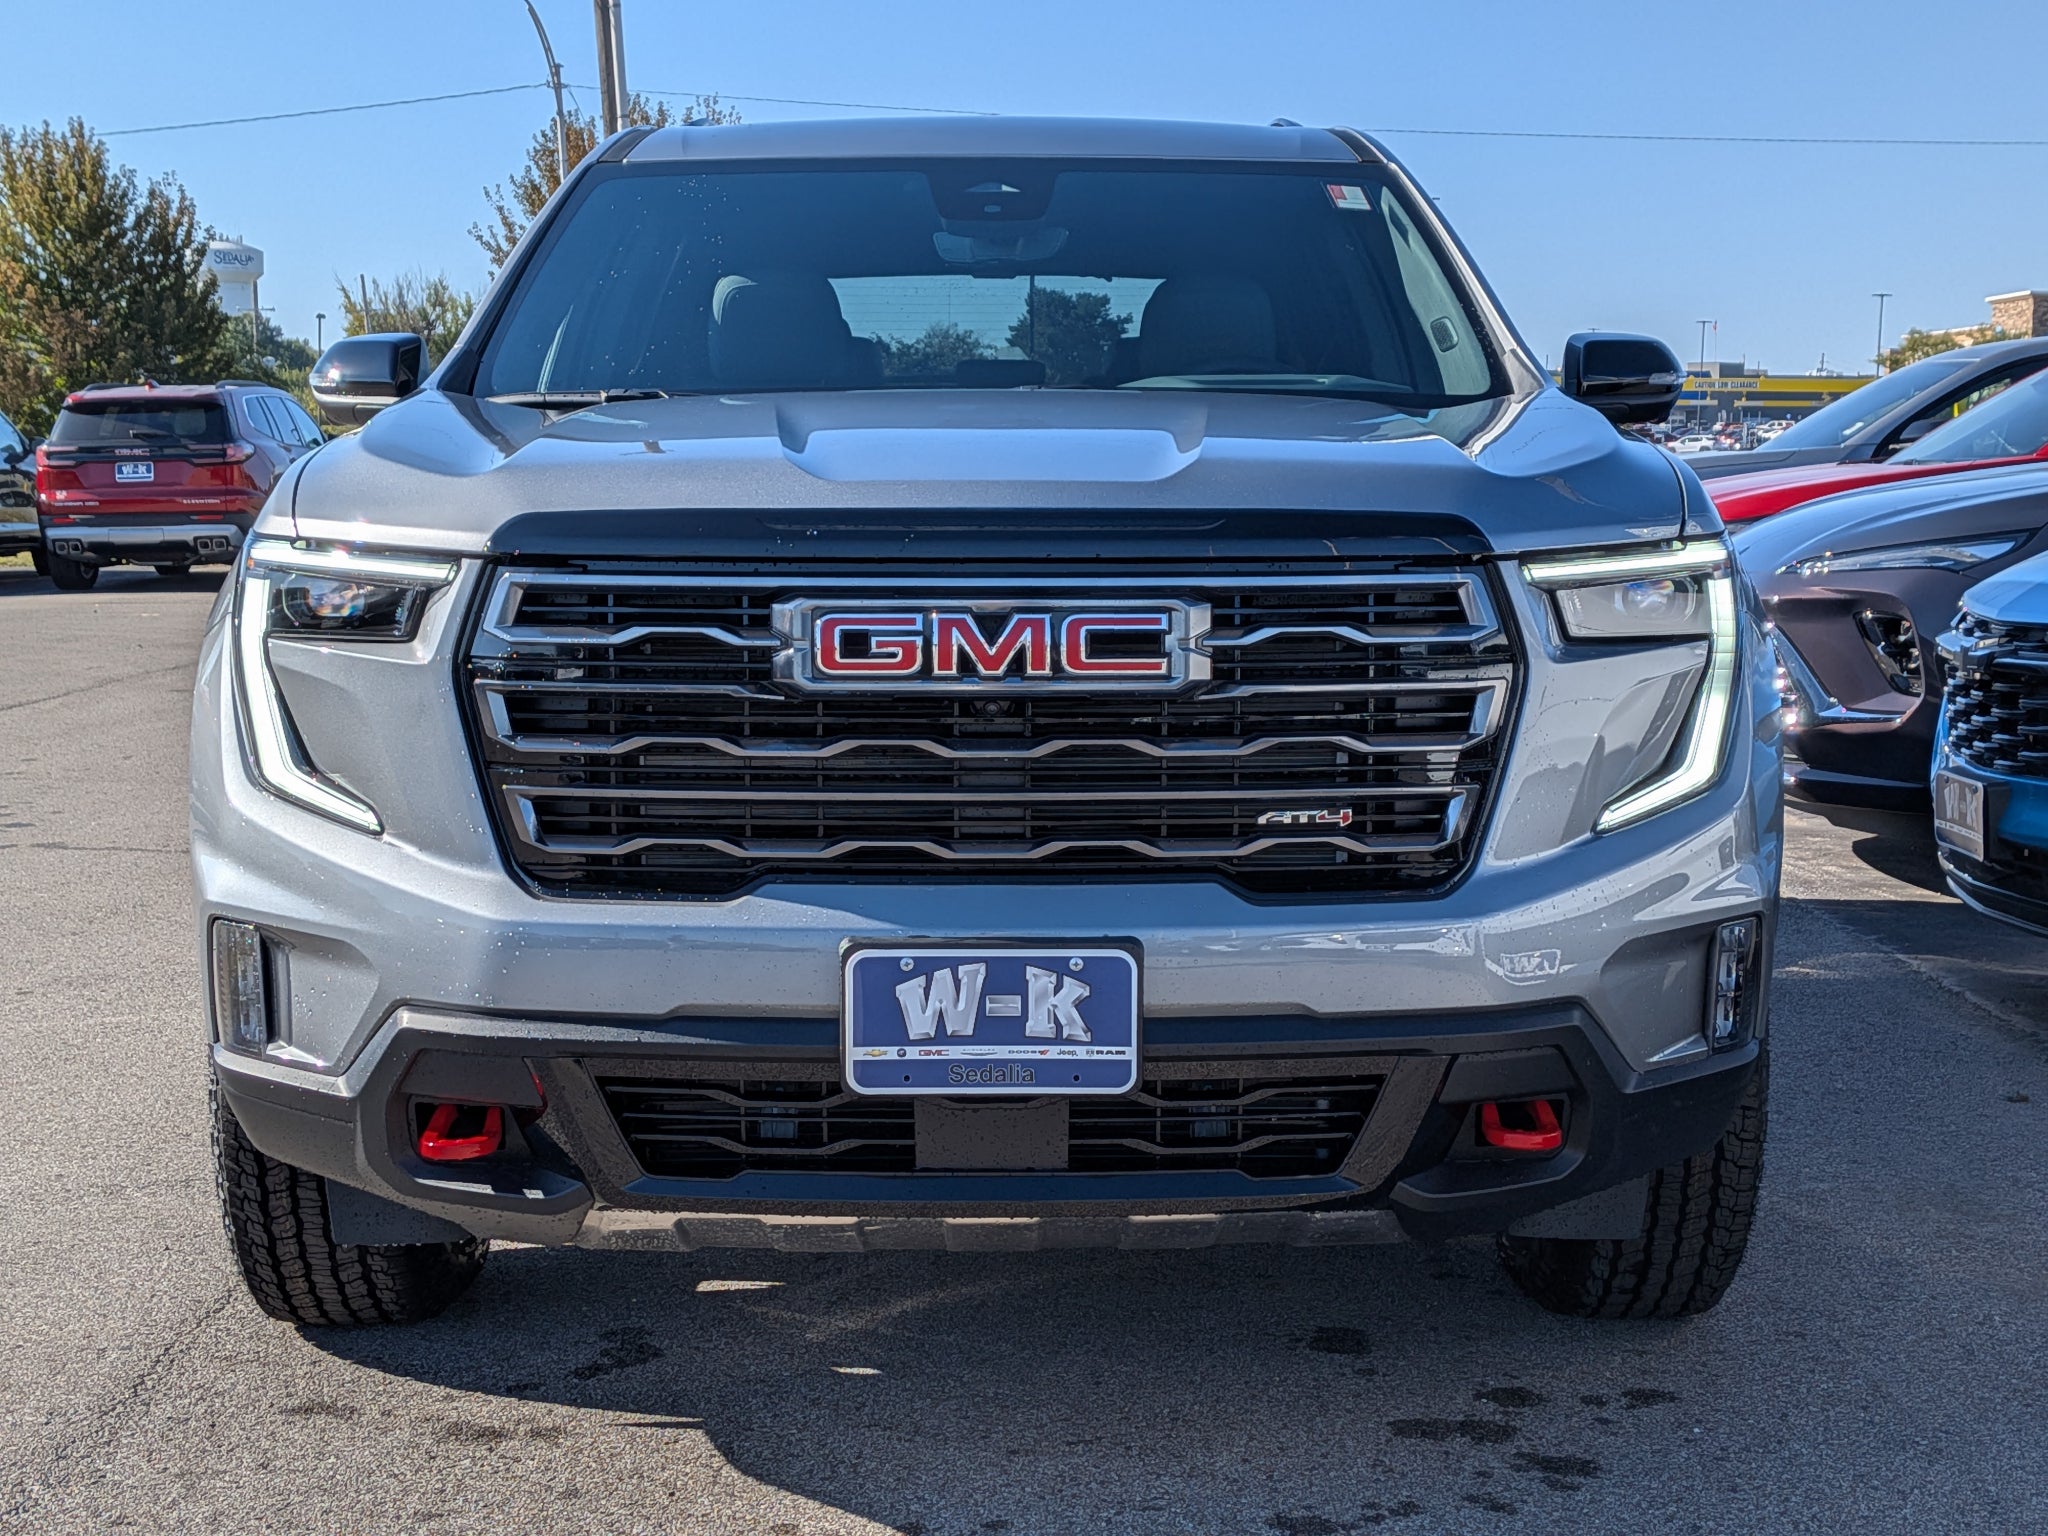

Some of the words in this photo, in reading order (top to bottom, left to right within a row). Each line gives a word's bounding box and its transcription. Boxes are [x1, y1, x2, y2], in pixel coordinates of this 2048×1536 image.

[121, 463, 147, 474] W-K
[814, 613, 1168, 676] GMC
[1944, 783, 1977, 830] W-K
[1258, 809, 1352, 826] AT4
[895, 962, 1092, 1042] W-K
[1057, 1048, 1077, 1057] Jeep
[948, 1063, 1035, 1083] Sedalia
